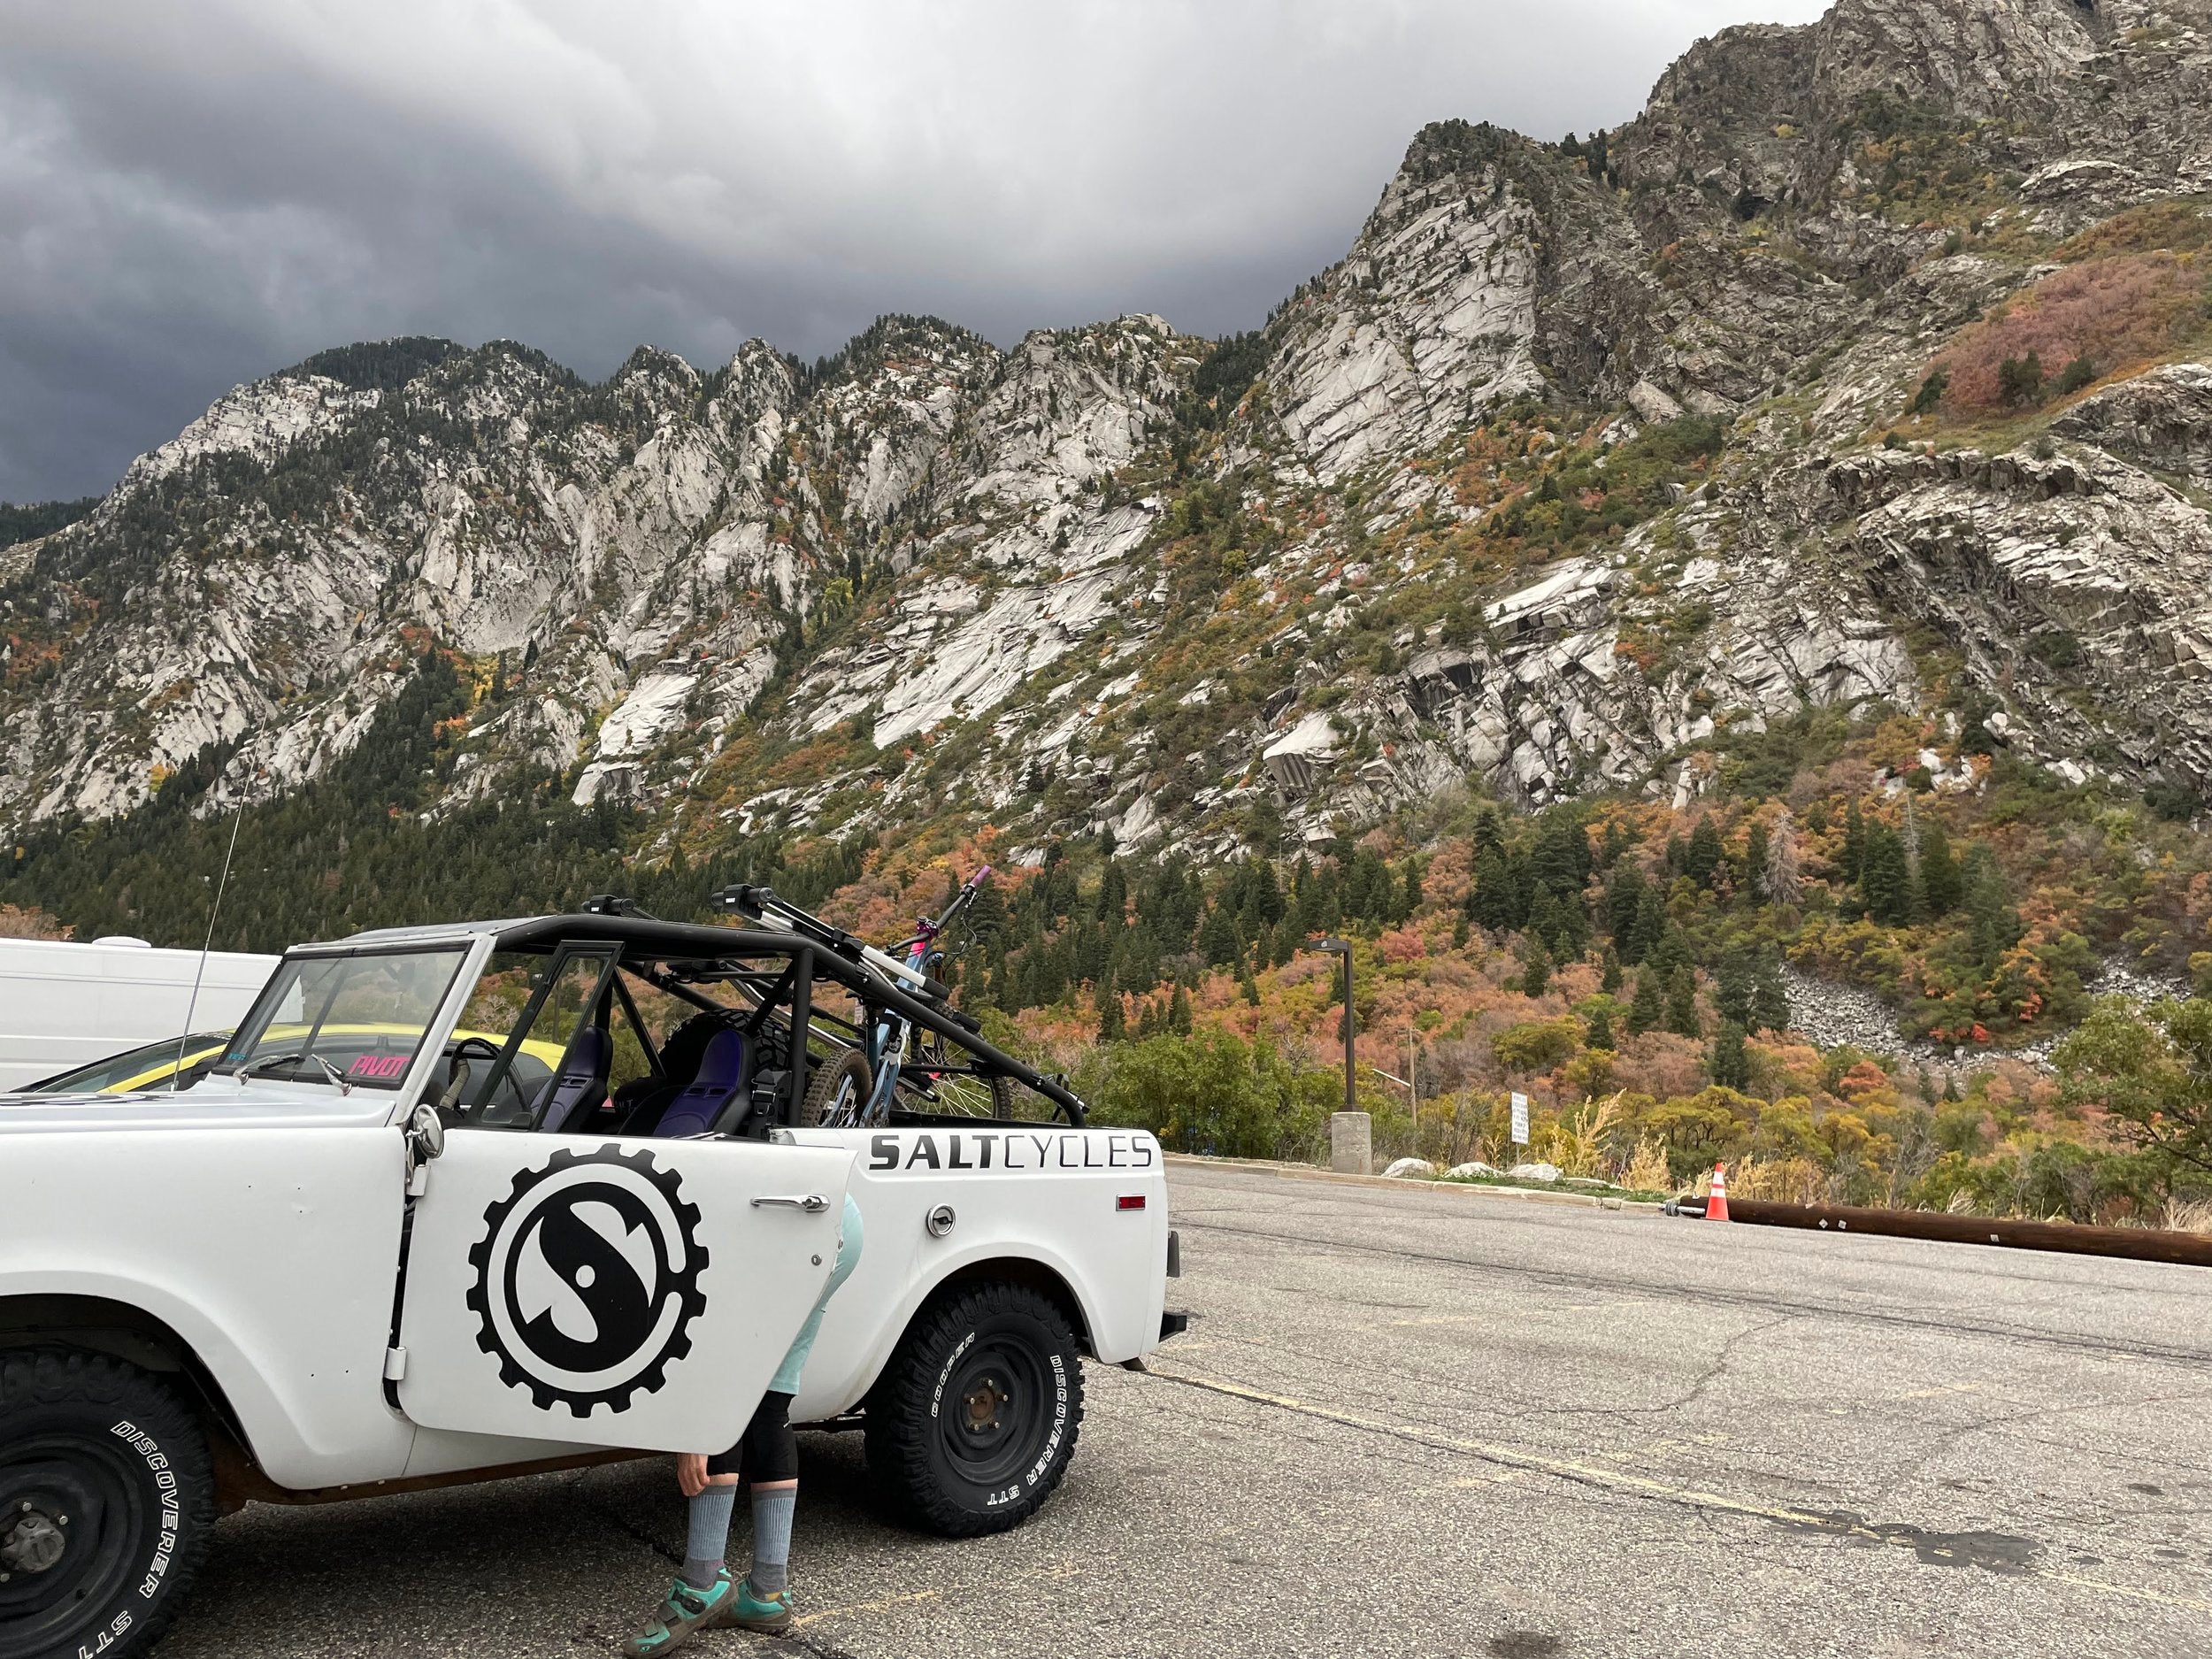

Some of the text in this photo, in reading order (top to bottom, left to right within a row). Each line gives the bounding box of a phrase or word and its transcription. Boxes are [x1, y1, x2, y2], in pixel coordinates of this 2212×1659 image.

[348, 1054, 411, 1077] PIVOT
[931, 1332, 975, 1417] COOPER
[987, 1355, 1067, 1506] DISCOVERER STT
[79, 1420, 180, 1659] DISCOVERER STT
